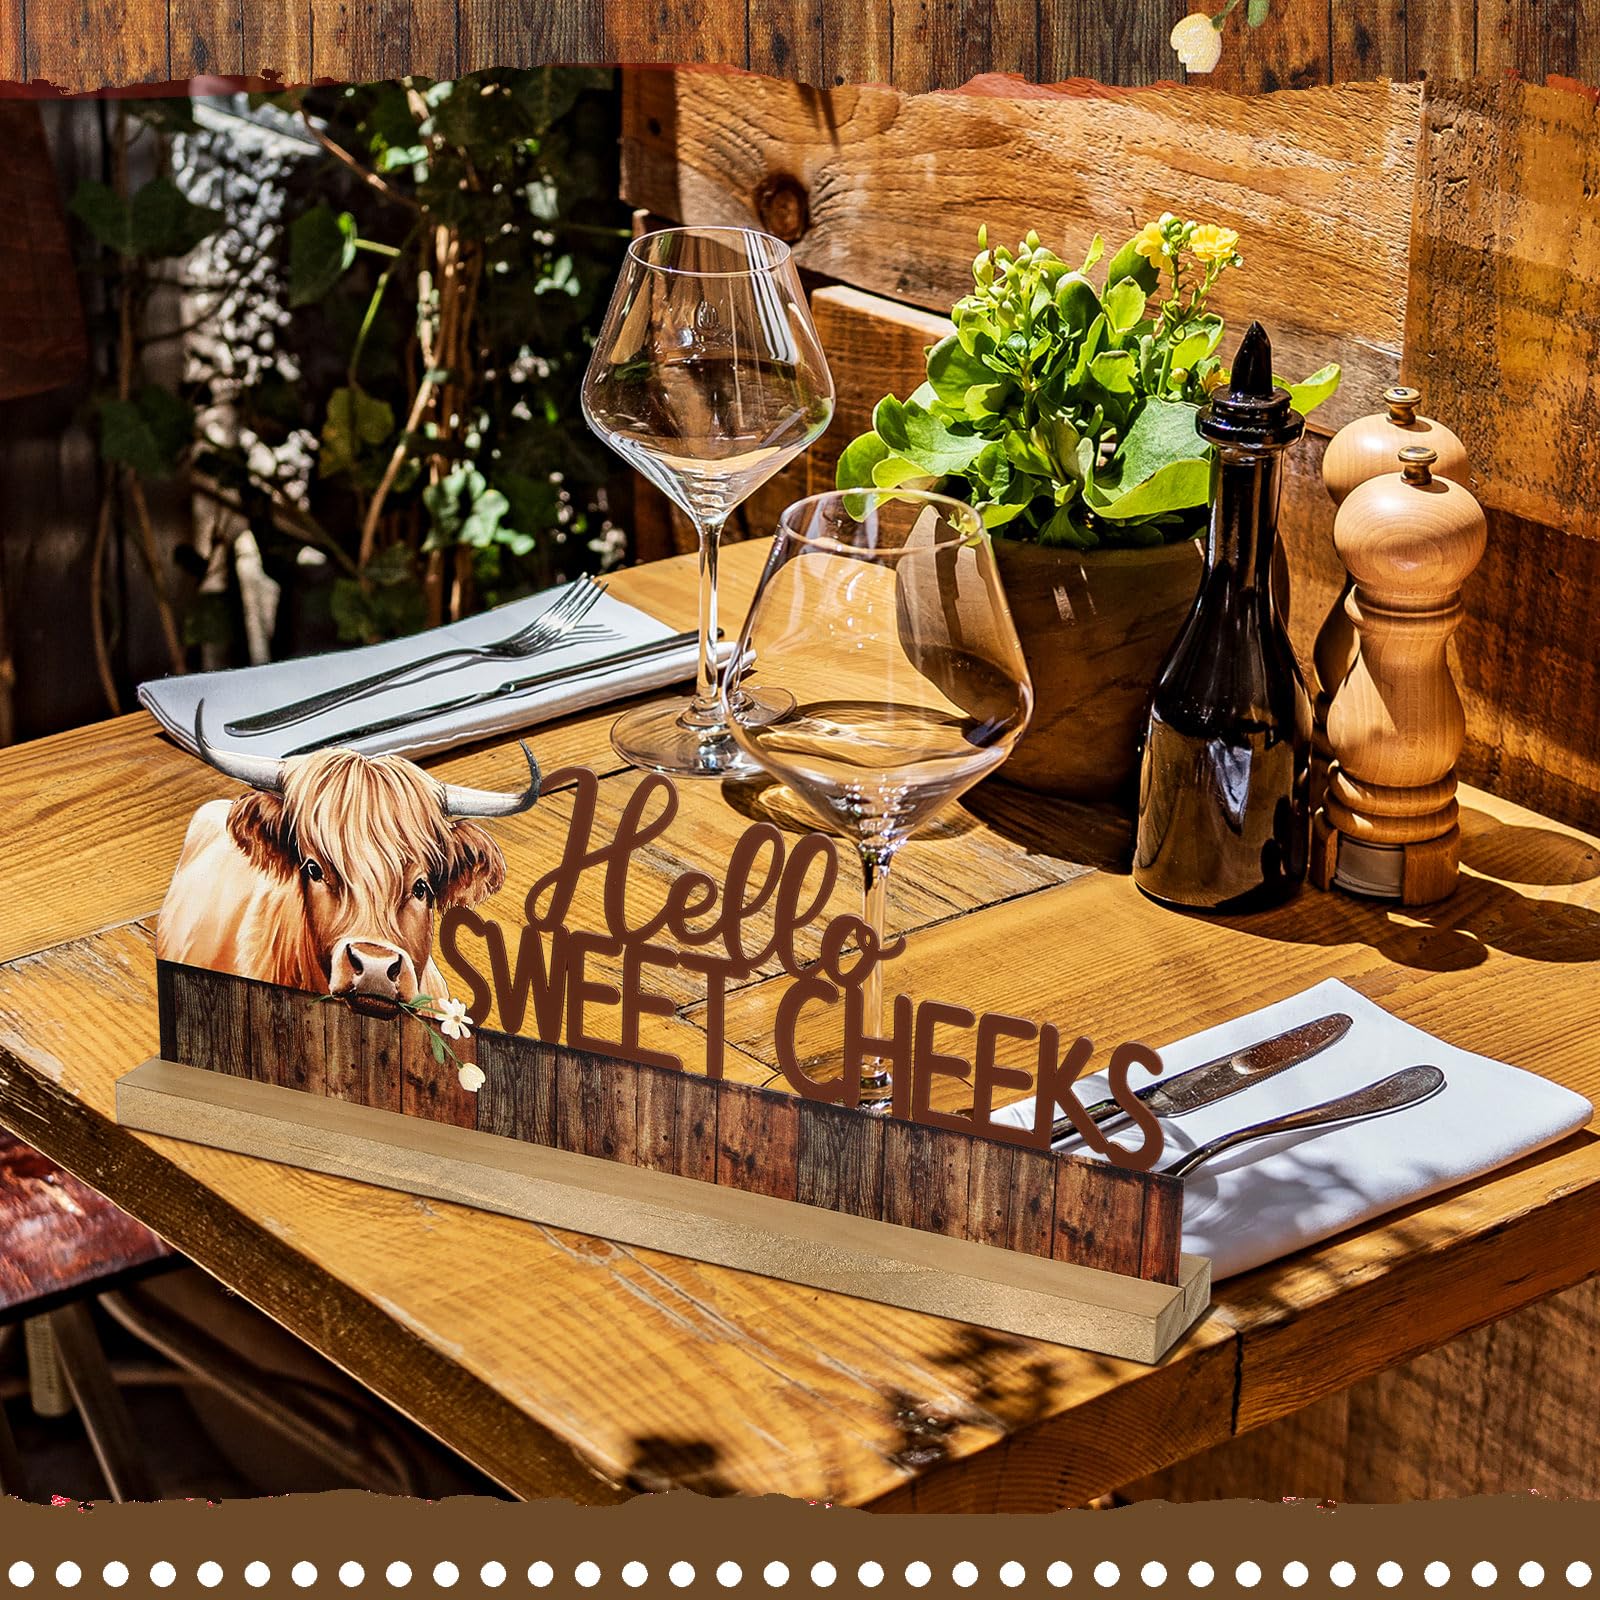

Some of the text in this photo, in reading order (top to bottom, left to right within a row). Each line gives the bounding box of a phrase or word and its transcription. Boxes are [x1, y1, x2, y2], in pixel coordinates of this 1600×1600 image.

[525, 766, 906, 988] Hello
[439, 905, 1164, 1171] SWEET CHEEKS
